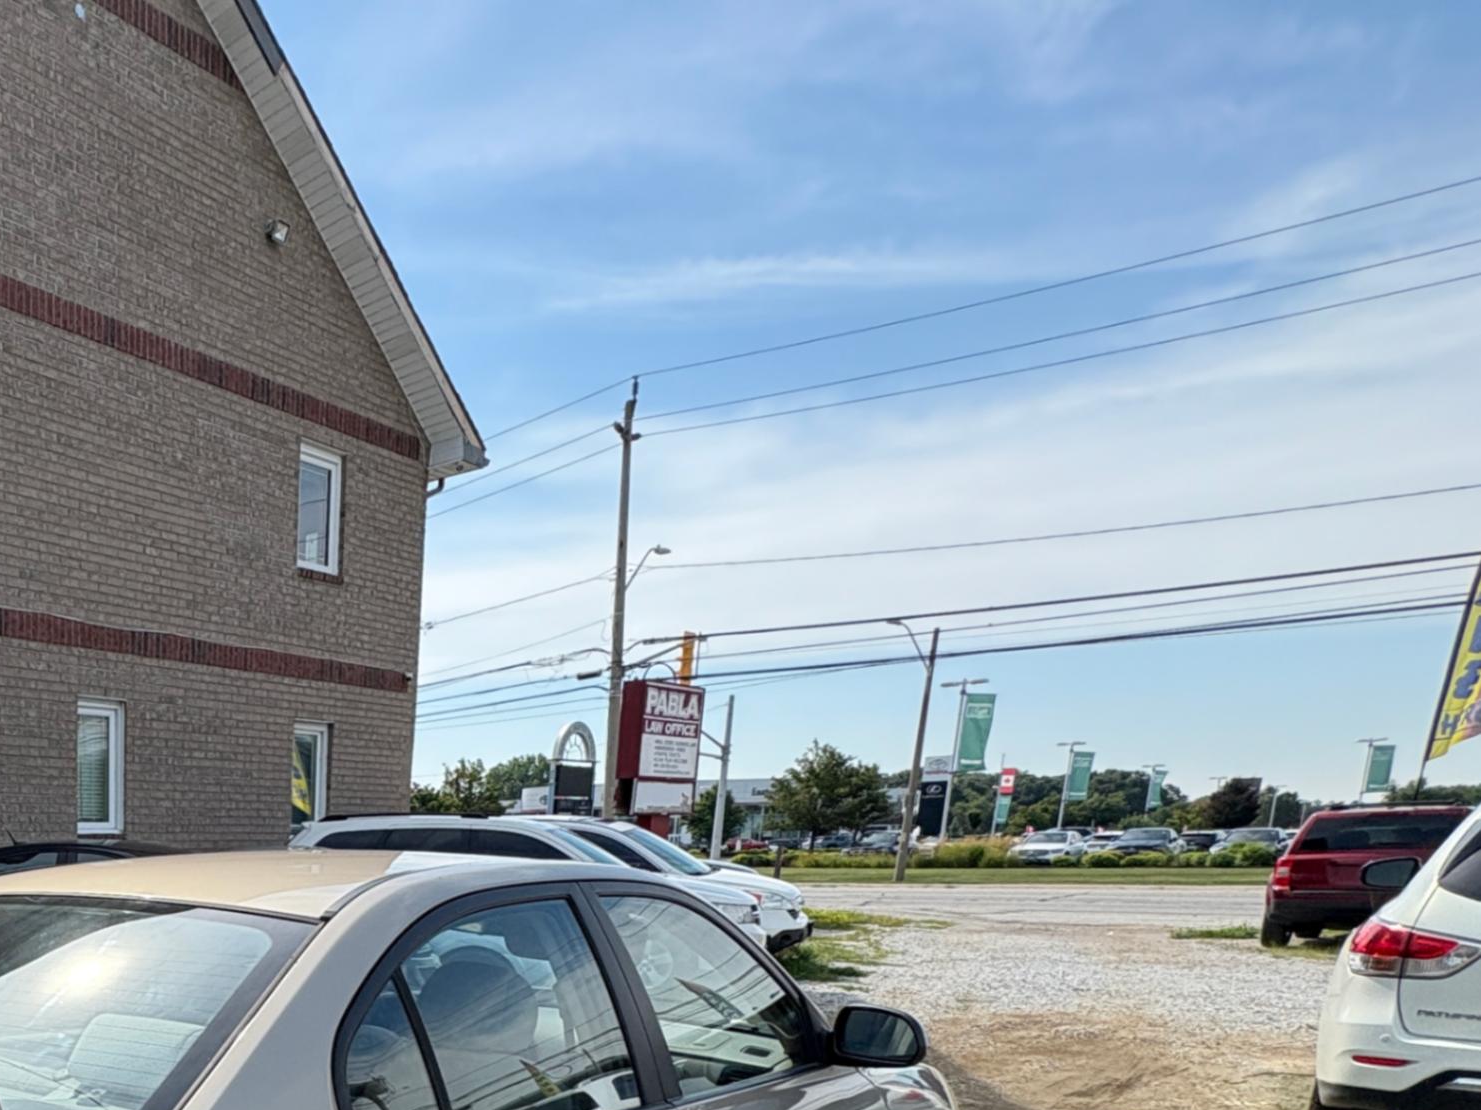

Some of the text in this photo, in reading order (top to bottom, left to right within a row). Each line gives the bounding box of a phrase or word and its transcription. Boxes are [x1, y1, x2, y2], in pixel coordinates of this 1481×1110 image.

[645, 686, 700, 720] PABLA
[645, 720, 697, 737] LAW OFFICE
